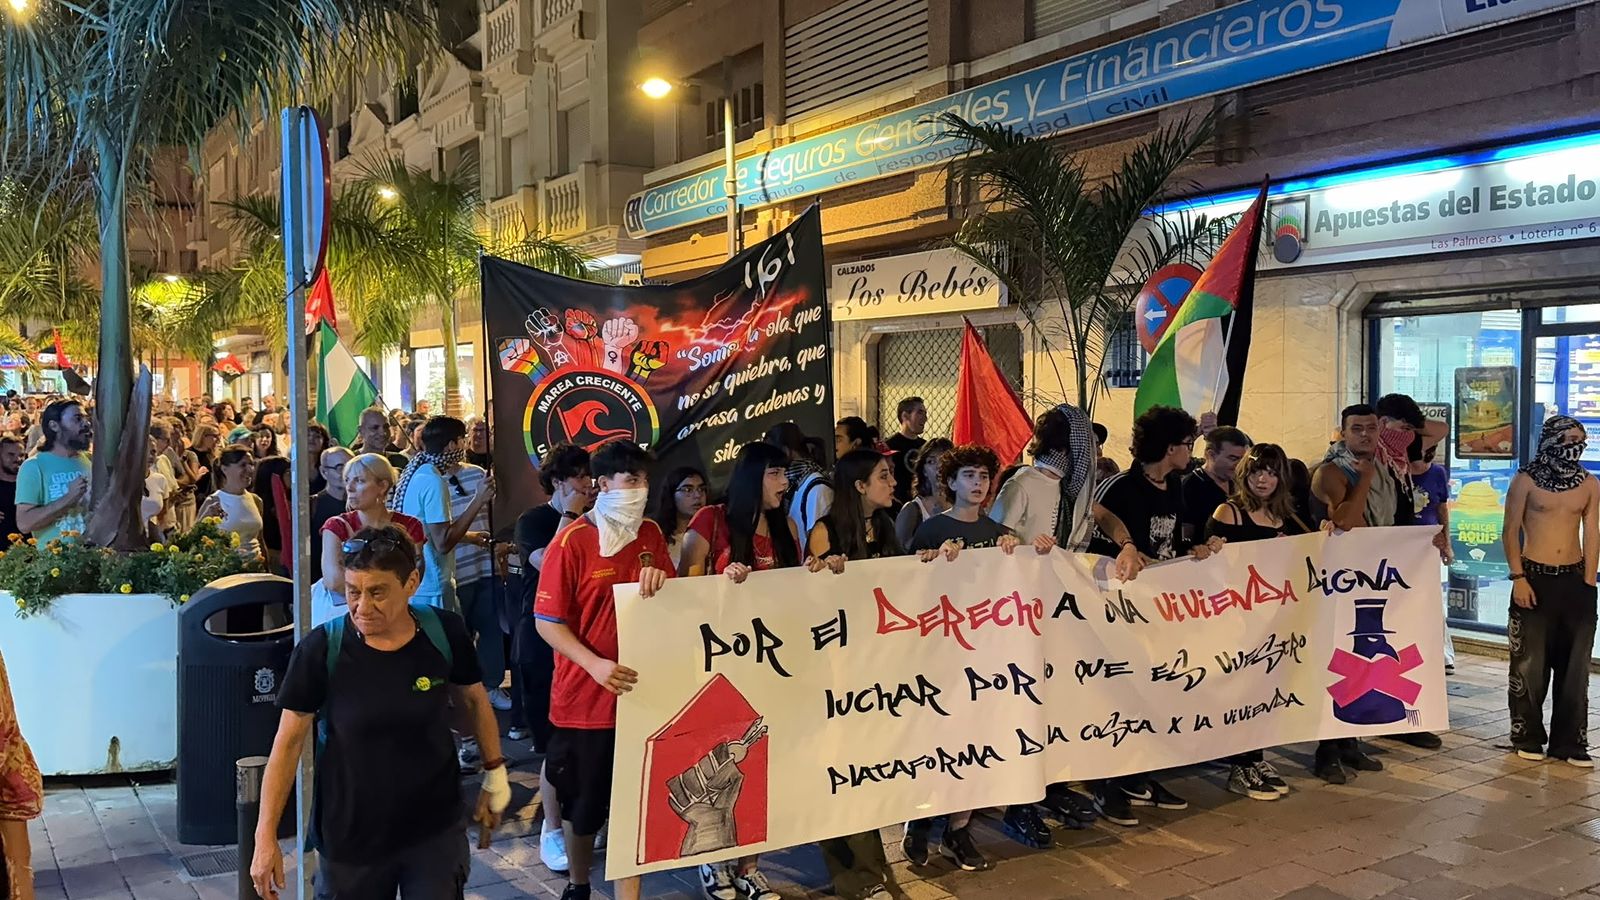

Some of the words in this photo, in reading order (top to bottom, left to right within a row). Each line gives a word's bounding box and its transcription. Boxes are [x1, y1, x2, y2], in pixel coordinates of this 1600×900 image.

[643, 175, 718, 216] Corredor
[754, 137, 847, 186] Seguros
[855, 88, 1010, 156] Generales
[1060, 0, 1343, 102] Financieros
[833, 168, 857, 184] de
[1106, 86, 1169, 115] civil
[1314, 199, 1430, 237] Apuestas
[1438, 186, 1480, 217] del
[1489, 173, 1596, 211] Estado
[1431, 238, 1449, 250] Las
[1452, 233, 1502, 247] Palmeras
[1589, 221, 1597, 233] 6
[744, 232, 795, 299] 161
[837, 263, 875, 276] CALZADOS
[837, 276, 885, 316] Los
[897, 266, 996, 304] Bebés
[765, 311, 789, 337] ola
[794, 305, 822, 334] que
[538, 379, 574, 413] MAREA
[575, 376, 643, 412] CRECIENTE
[677, 393, 700, 411] no
[724, 355, 792, 396] quiebra,
[797, 344, 826, 371] que
[677, 408, 738, 441] arrasa
[744, 384, 810, 420] cadenas
[814, 383, 826, 405] y
[700, 617, 793, 677] POR
[1051, 591, 1087, 620] A
[964, 662, 1043, 705] POR
[1075, 658, 1134, 685] QUE
